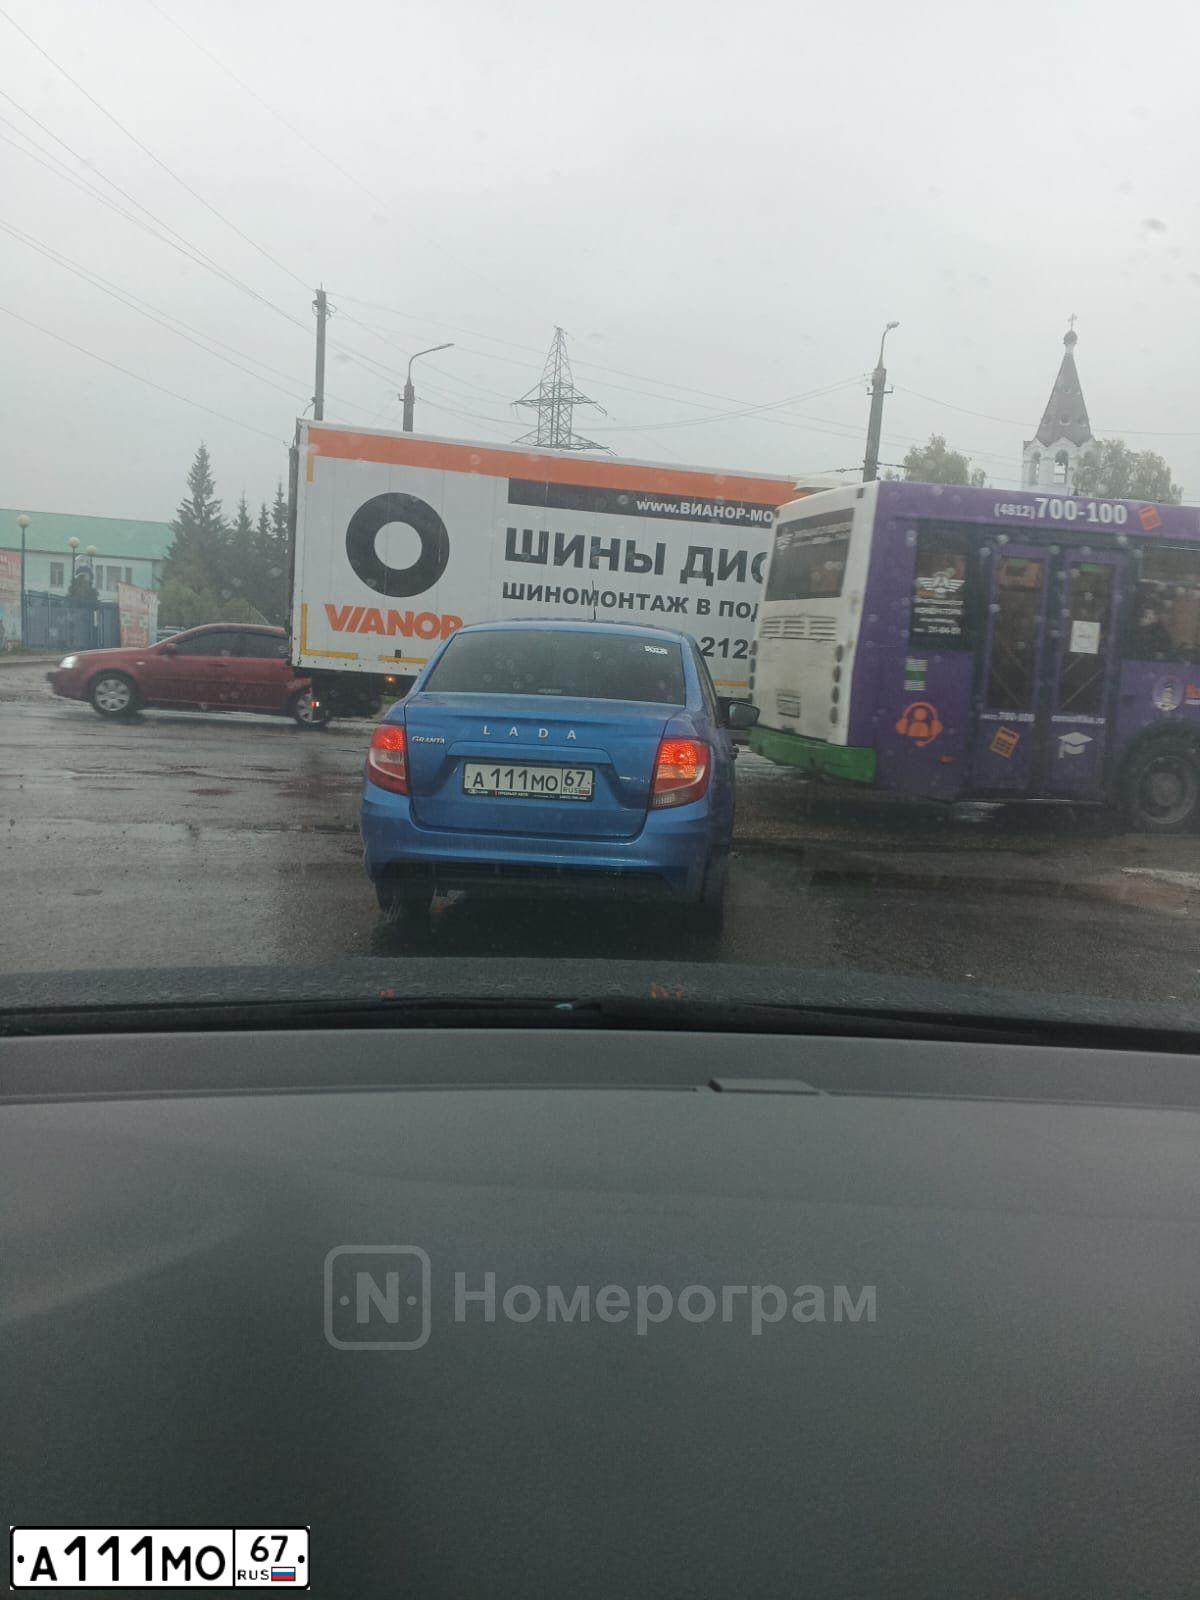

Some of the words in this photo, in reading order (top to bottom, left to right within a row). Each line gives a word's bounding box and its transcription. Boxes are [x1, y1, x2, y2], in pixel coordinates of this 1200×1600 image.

[504, 527, 667, 576] ШИНЫ
[502, 581, 689, 614] ШИНОМОНТАЖ
[696, 598, 711, 615] В
[324, 603, 464, 641] VIANOR
[700, 636, 753, 660] 212
[411, 735, 446, 745] GRANTA
[482, 724, 577, 740] LADA
[472, 768, 559, 792] А111МО
[564, 770, 586, 788] 67
[562, 786, 578, 795] RUS
